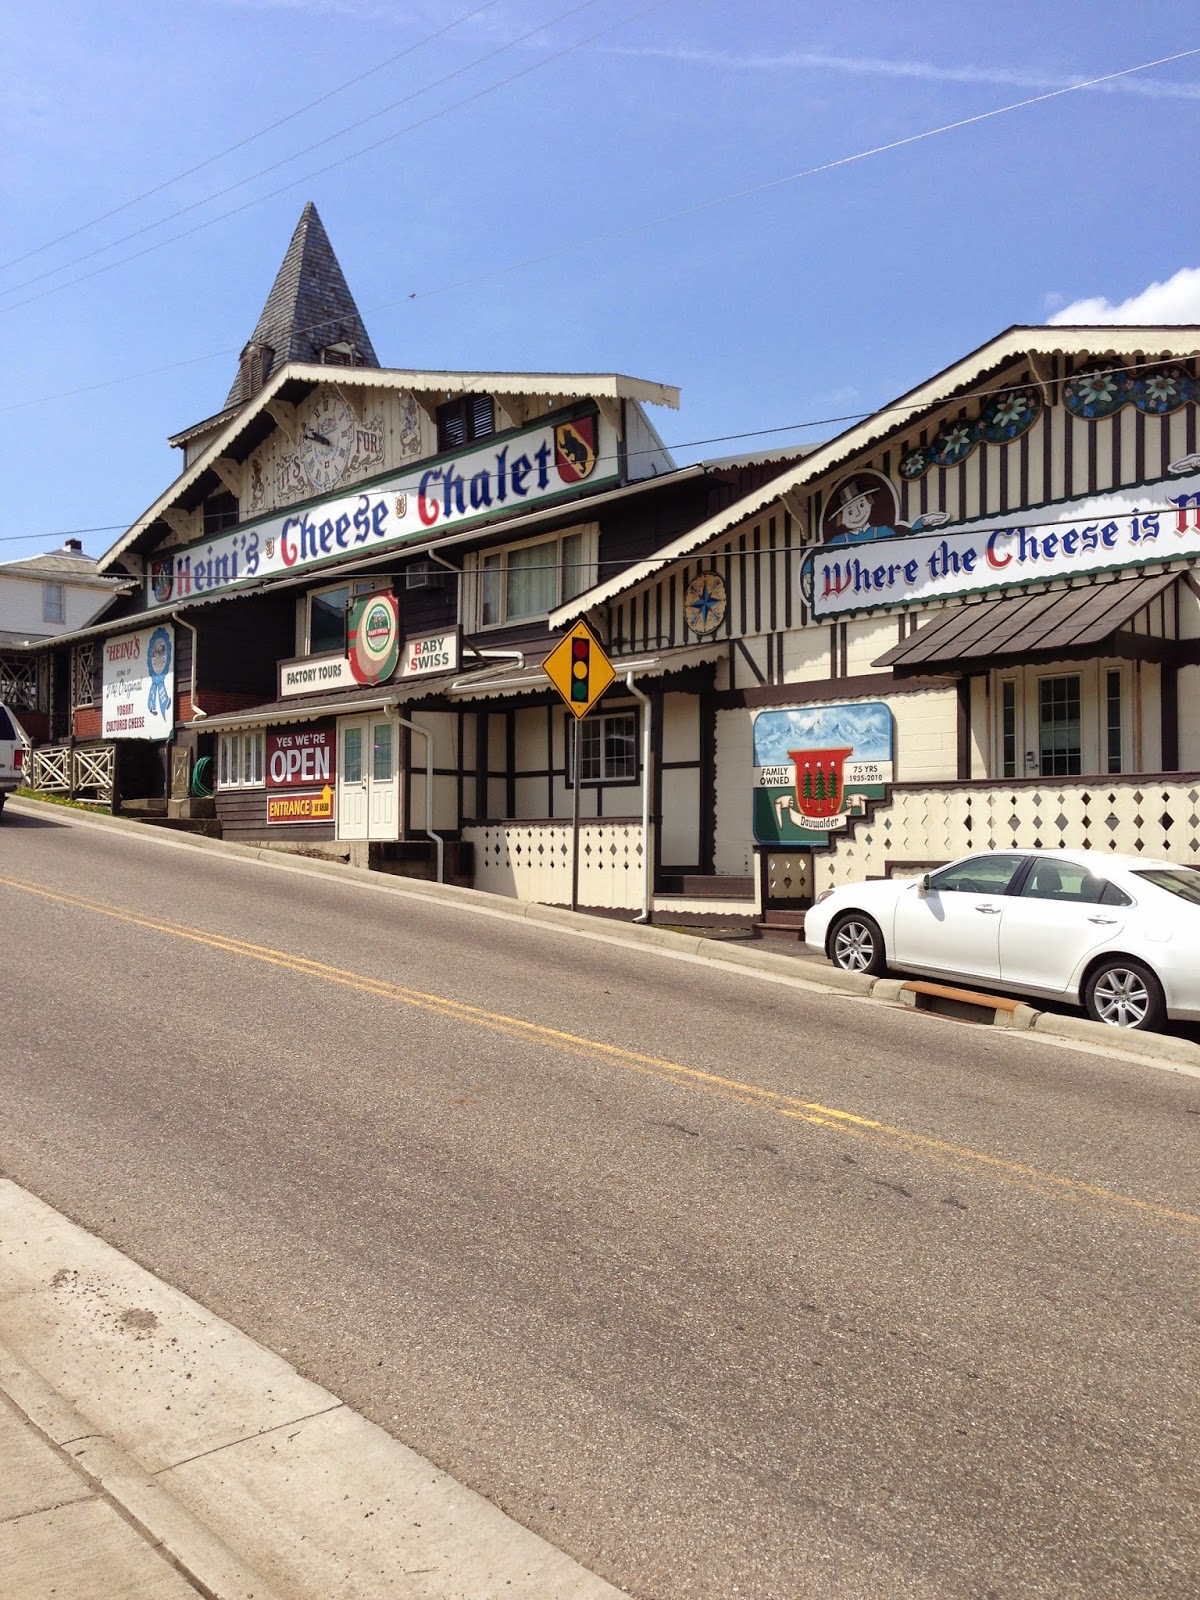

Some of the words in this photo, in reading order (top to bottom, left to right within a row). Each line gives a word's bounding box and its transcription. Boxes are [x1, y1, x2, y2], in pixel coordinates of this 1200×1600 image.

[356, 429, 377, 454] FOR
[176, 532, 260, 597] Heini's
[281, 494, 389, 567] Cheese
[417, 438, 553, 526] Chalet
[821, 557, 919, 598] Where
[928, 540, 977, 577] the
[987, 520, 1119, 567] Cheese
[1130, 507, 1160, 542] is
[106, 635, 140, 662] HEINI'S
[414, 638, 445, 655] BABY
[410, 652, 449, 672] SWISS
[287, 668, 317, 685] FACTORY
[318, 663, 342, 679] TOURS
[117, 703, 134, 716] YOGURT
[106, 719, 127, 733] CULTURED
[128, 716, 145, 729] CHEESE
[276, 736, 292, 748] YES
[295, 733, 326, 746] WE'RE
[270, 746, 330, 783] OPEN
[762, 767, 788, 776] FAMILY
[853, 765, 863, 773] 75
[865, 765, 878, 773] YRS
[760, 776, 790, 785] OWNED
[849, 774, 883, 782] 1935-2010
[269, 799, 310, 817] ENTRANCE
[800, 816, 839, 828] Dauwalder
